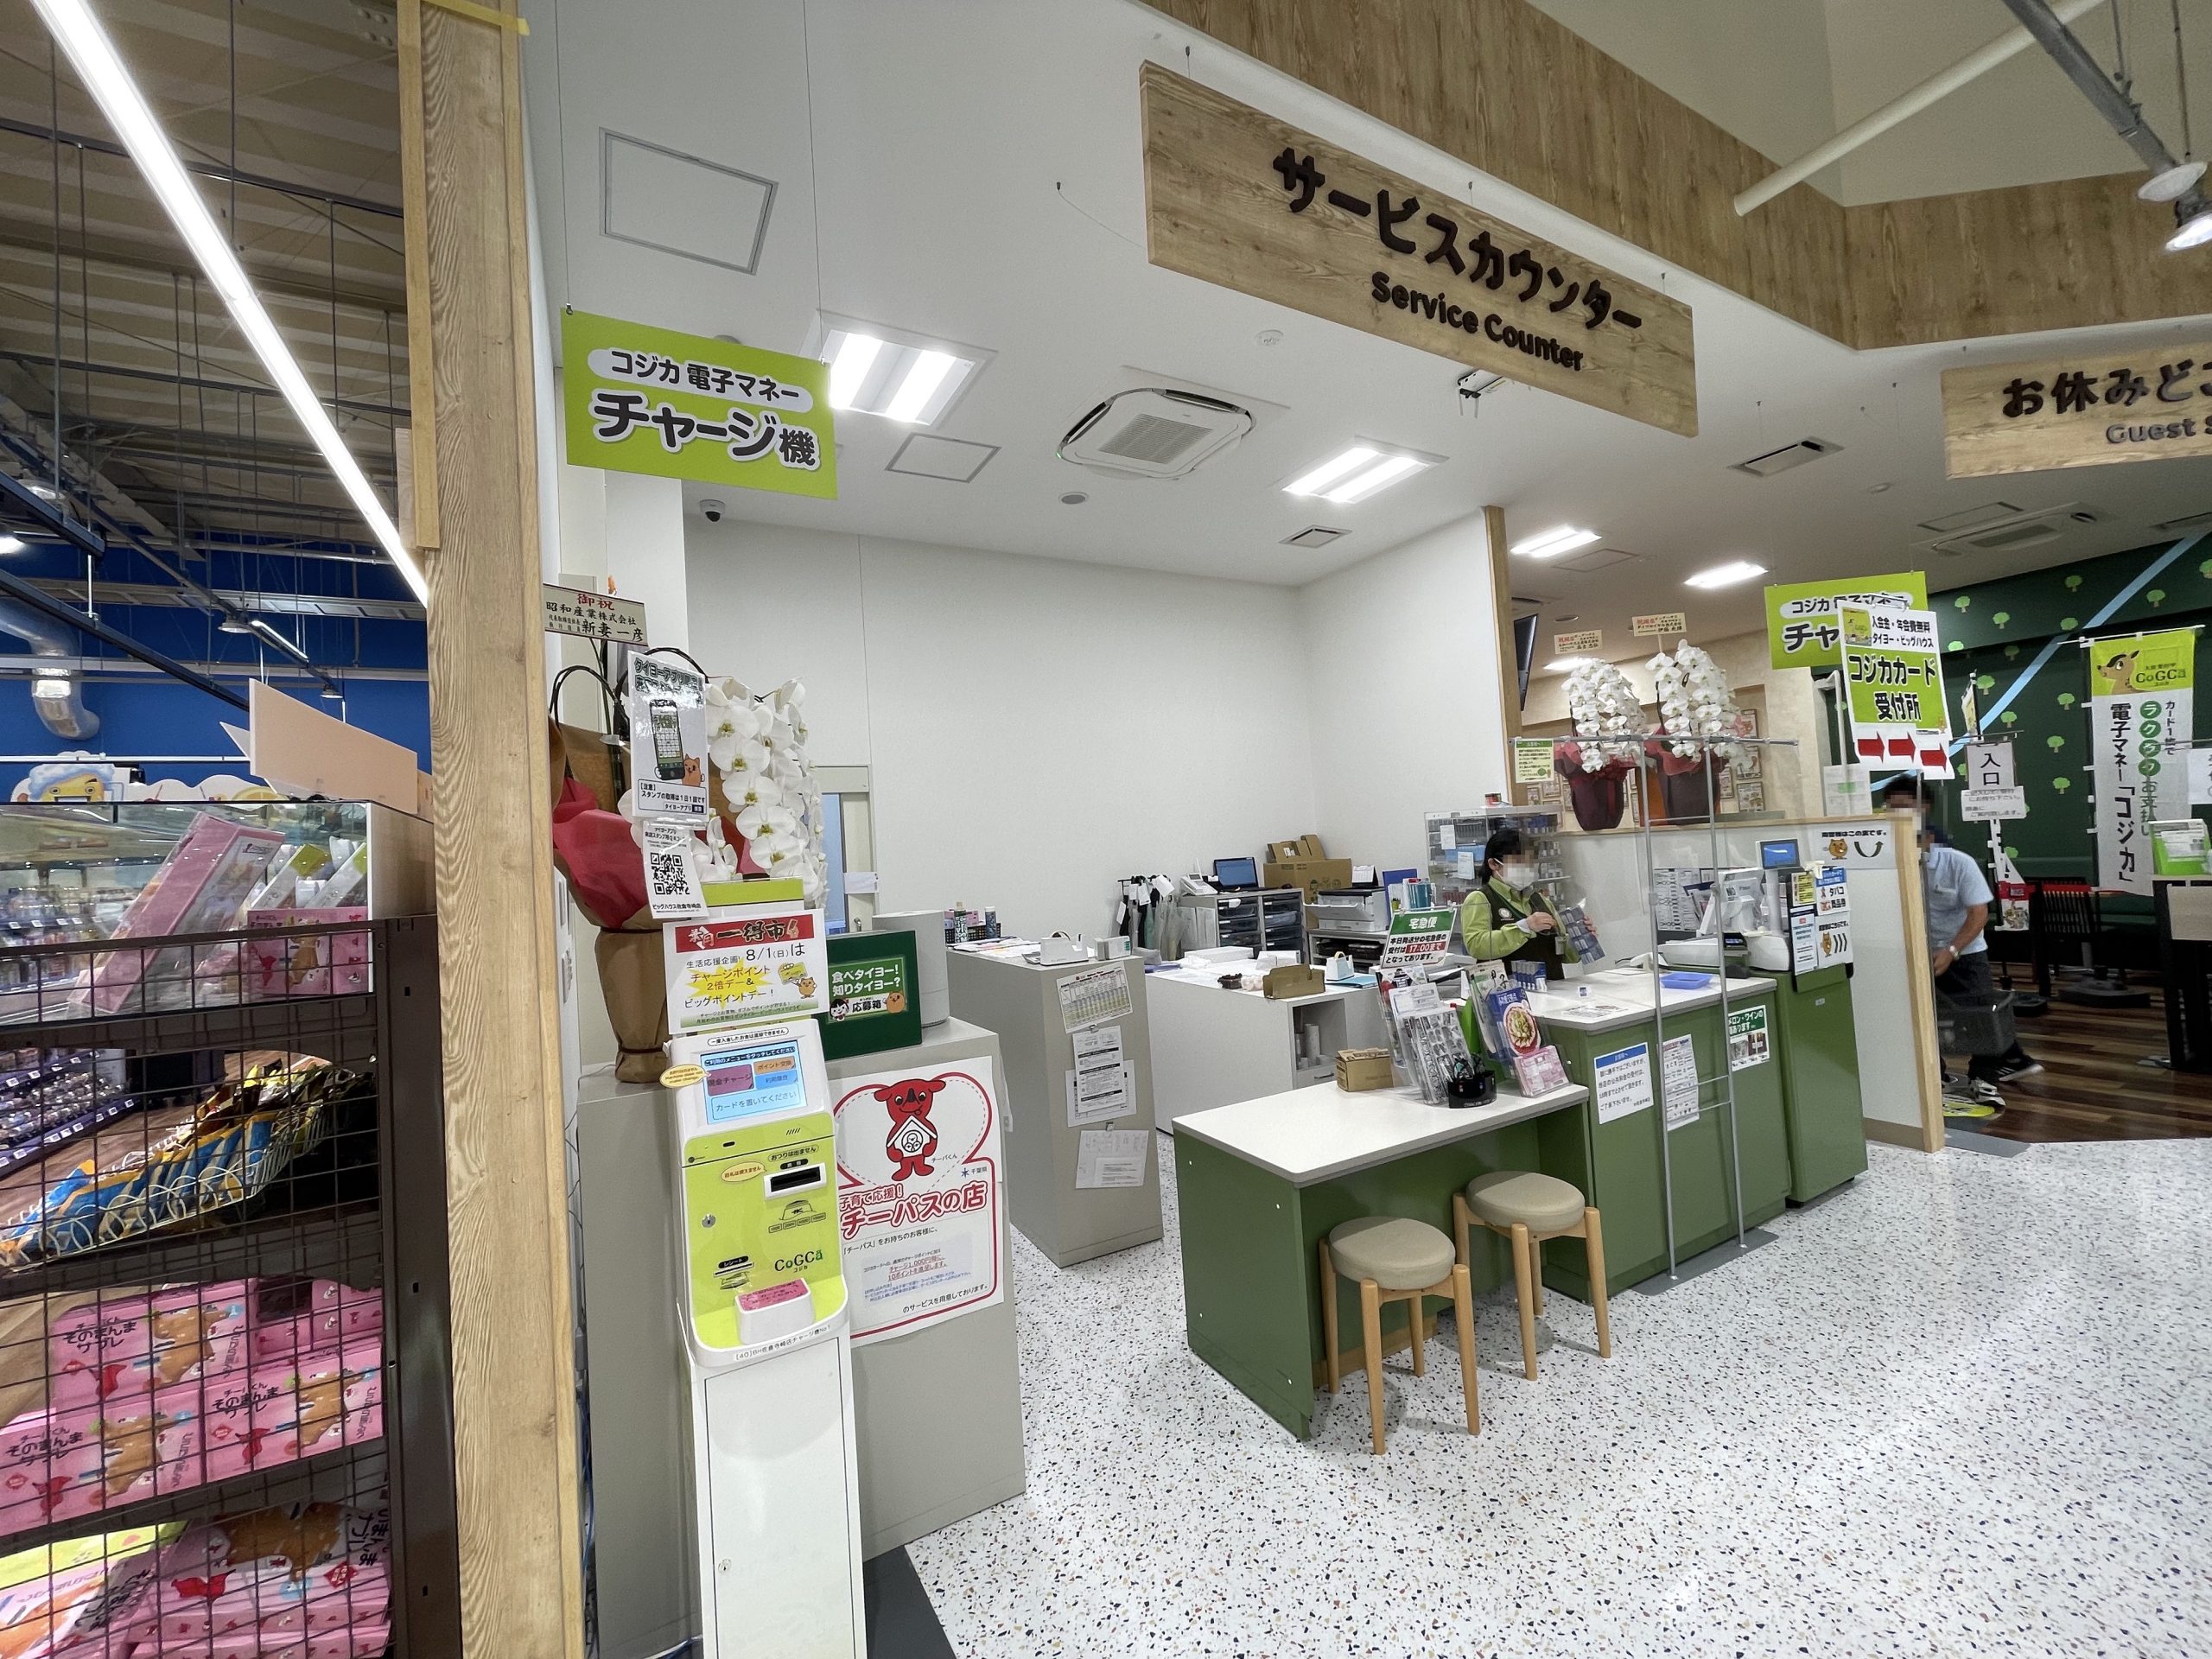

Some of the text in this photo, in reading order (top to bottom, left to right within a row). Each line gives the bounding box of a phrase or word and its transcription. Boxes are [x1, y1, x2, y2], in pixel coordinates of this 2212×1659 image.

[1274, 146, 1642, 330] サービスカウンター
[1371, 270, 1583, 372] Service Counter
[611, 349, 799, 401] コジカ 電子マネー
[2002, 358, 2212, 418] お休みど
[594, 393, 816, 467] チャージ機
[2106, 418, 2196, 444] Guest
[546, 601, 637, 625] 昭和産業株式会社
[577, 594, 614, 611] 御祝
[1791, 599, 1831, 614] コジカ
[1847, 654, 1936, 687] コジカカード
[1874, 691, 1922, 721] 受付所
[1980, 753, 2001, 785] 入口
[2110, 702, 2136, 882] 電子マネー「コジカ」
[1409, 917, 1438, 930] 宅急便
[690, 965, 772, 983] チャージポイント
[831, 964, 899, 983] 食べタイヨー!
[832, 977, 901, 996] 知りタイヨー?
[852, 1000, 881, 1013] 応募箱
[715, 1091, 797, 1112] カードを置いてください
[771, 1147, 817, 1161] おつりは出ません
[841, 1181, 988, 1240] チーパスの店
[723, 1258, 743, 1267] レシート
[902, 1283, 988, 1313] のサービスを用意しております。
